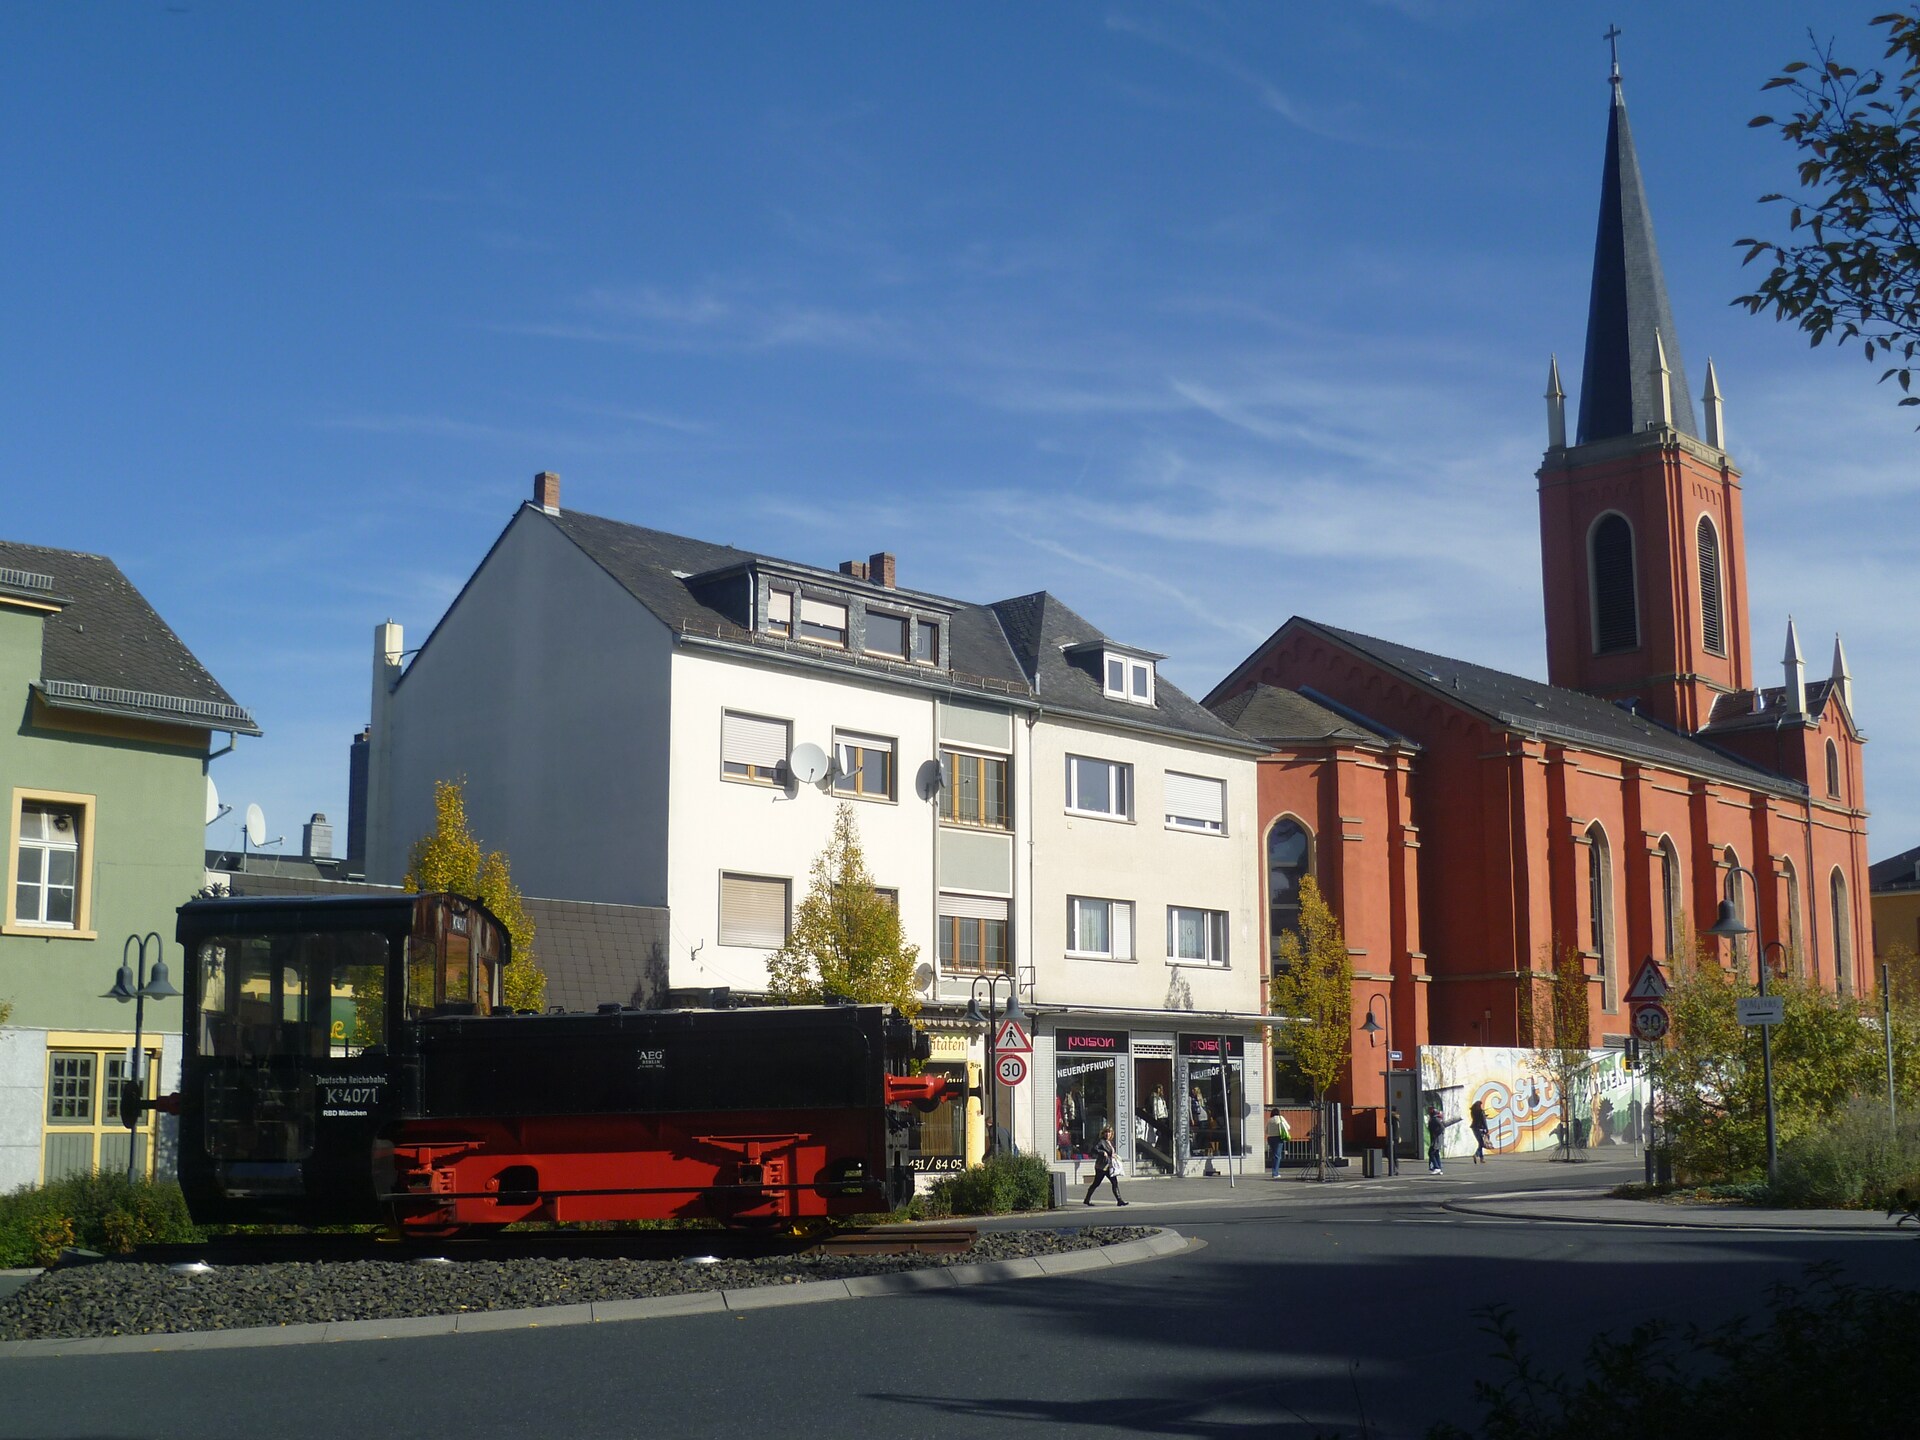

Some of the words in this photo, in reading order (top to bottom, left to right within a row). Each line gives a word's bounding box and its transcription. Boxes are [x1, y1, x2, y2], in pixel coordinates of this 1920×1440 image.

[1640, 1014, 1660, 1031] 30
[640, 1051, 662, 1060] AEG
[1002, 1062, 1020, 1077] 30
[1057, 1059, 1115, 1078] NEUERÖFFNUNG
[348, 1075, 386, 1084] Reichsbahn
[1118, 1063, 1126, 1108] Fashion
[1119, 1111, 1128, 1149] Young
[935, 1159, 948, 1170] 84
[950, 1159, 963, 1170] 05
